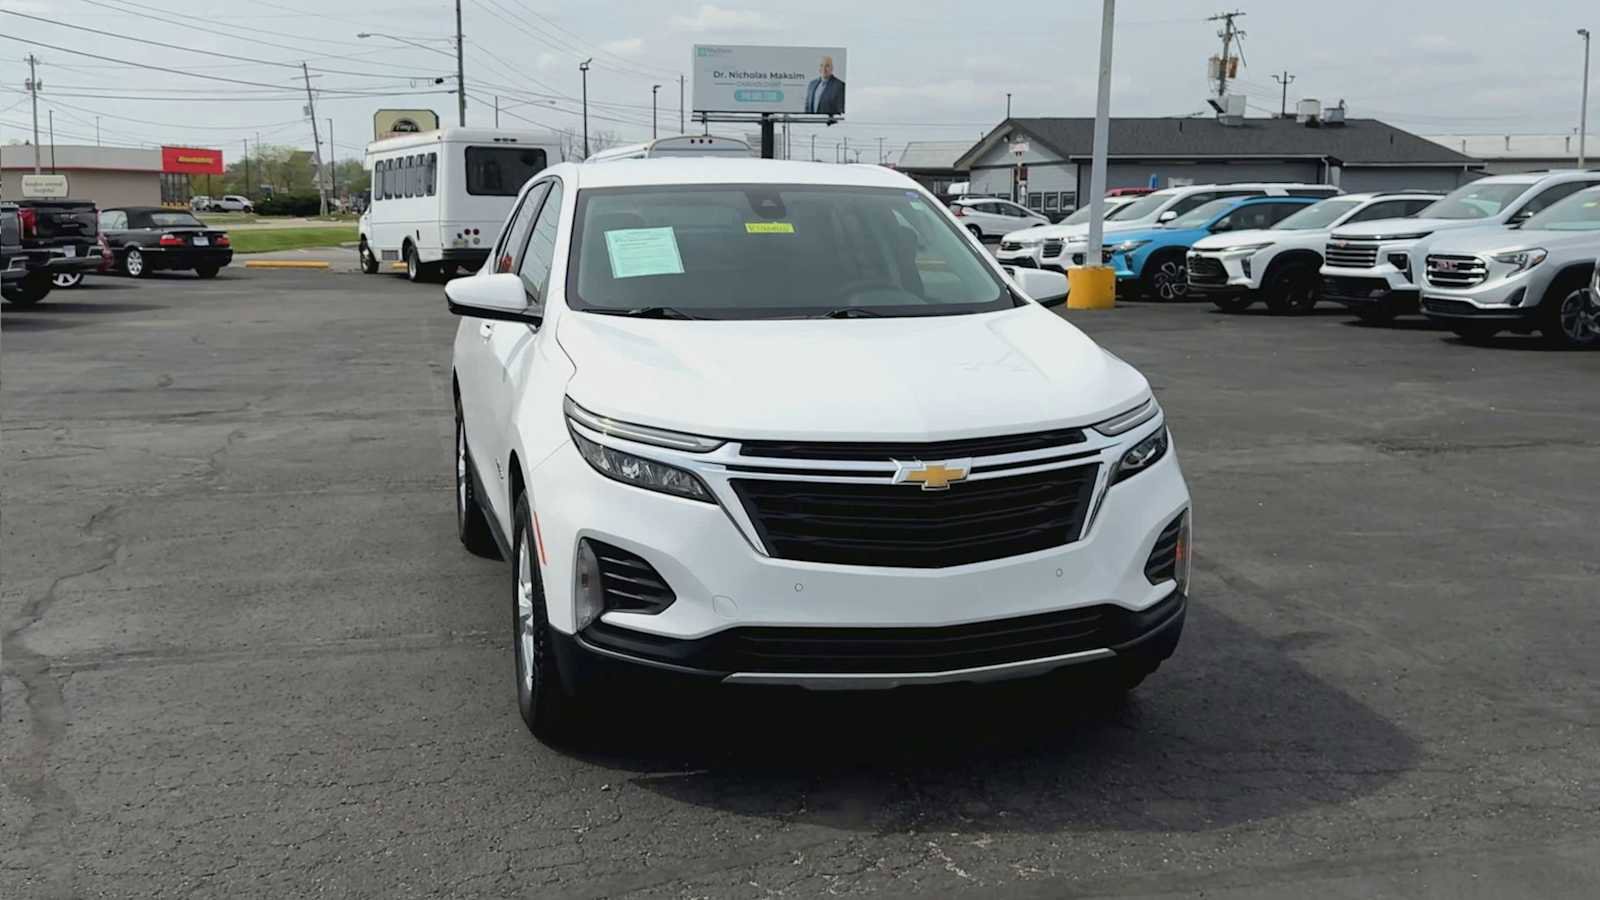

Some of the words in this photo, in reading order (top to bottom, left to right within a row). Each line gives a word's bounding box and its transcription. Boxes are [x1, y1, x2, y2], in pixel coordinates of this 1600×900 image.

[713, 70, 727, 79] Dr.
[729, 70, 767, 80] Nicholas
[769, 71, 805, 80] Maksim
